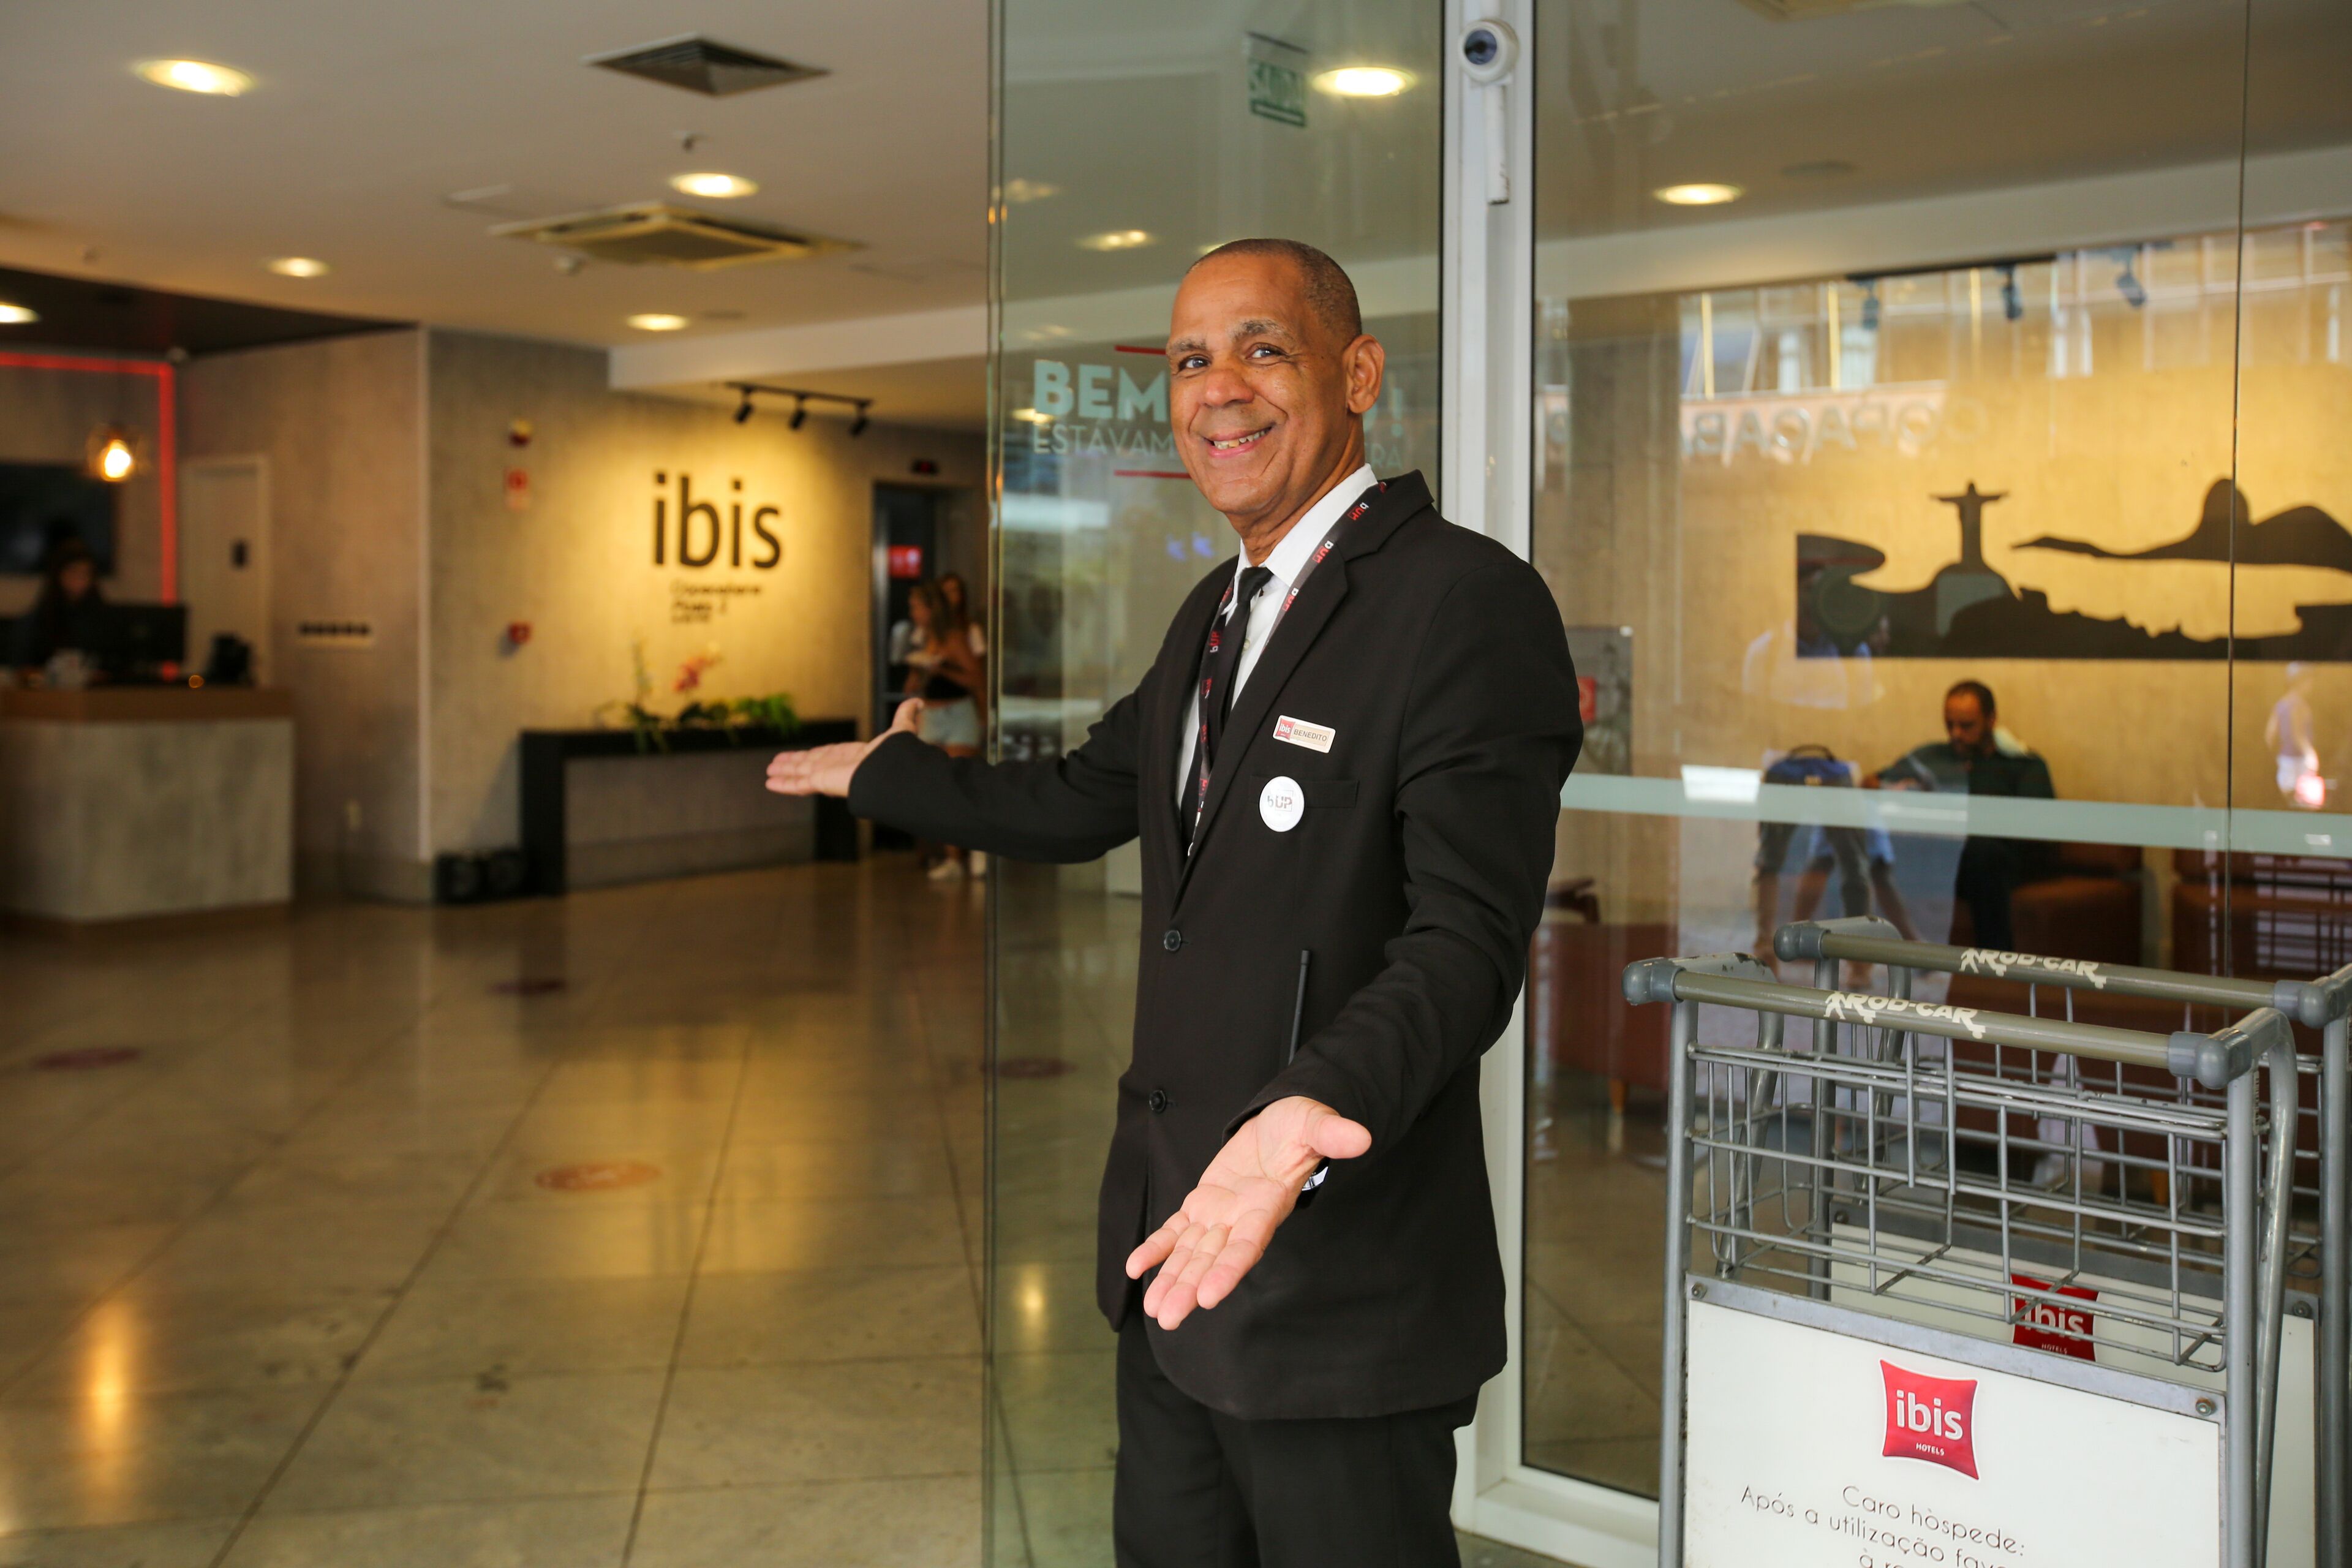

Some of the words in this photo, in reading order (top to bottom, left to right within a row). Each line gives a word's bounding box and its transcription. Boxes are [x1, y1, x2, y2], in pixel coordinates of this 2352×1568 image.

[655, 473, 781, 568] ibis
[1279, 724, 1291, 734] ibis
[1294, 729, 1327, 742] BENEDITO
[1978, 949, 2107, 989] ROD-CAR
[1844, 992, 1986, 1039] ROD-CAR
[1896, 1389, 1963, 1440] ibis
[1916, 1442, 1945, 1456] HOTELS
[1741, 1485, 1794, 1518] Após
[1805, 1509, 1818, 1525] a
[1830, 1515, 1944, 1561] utilização
[1842, 1485, 1900, 1520] Caro
